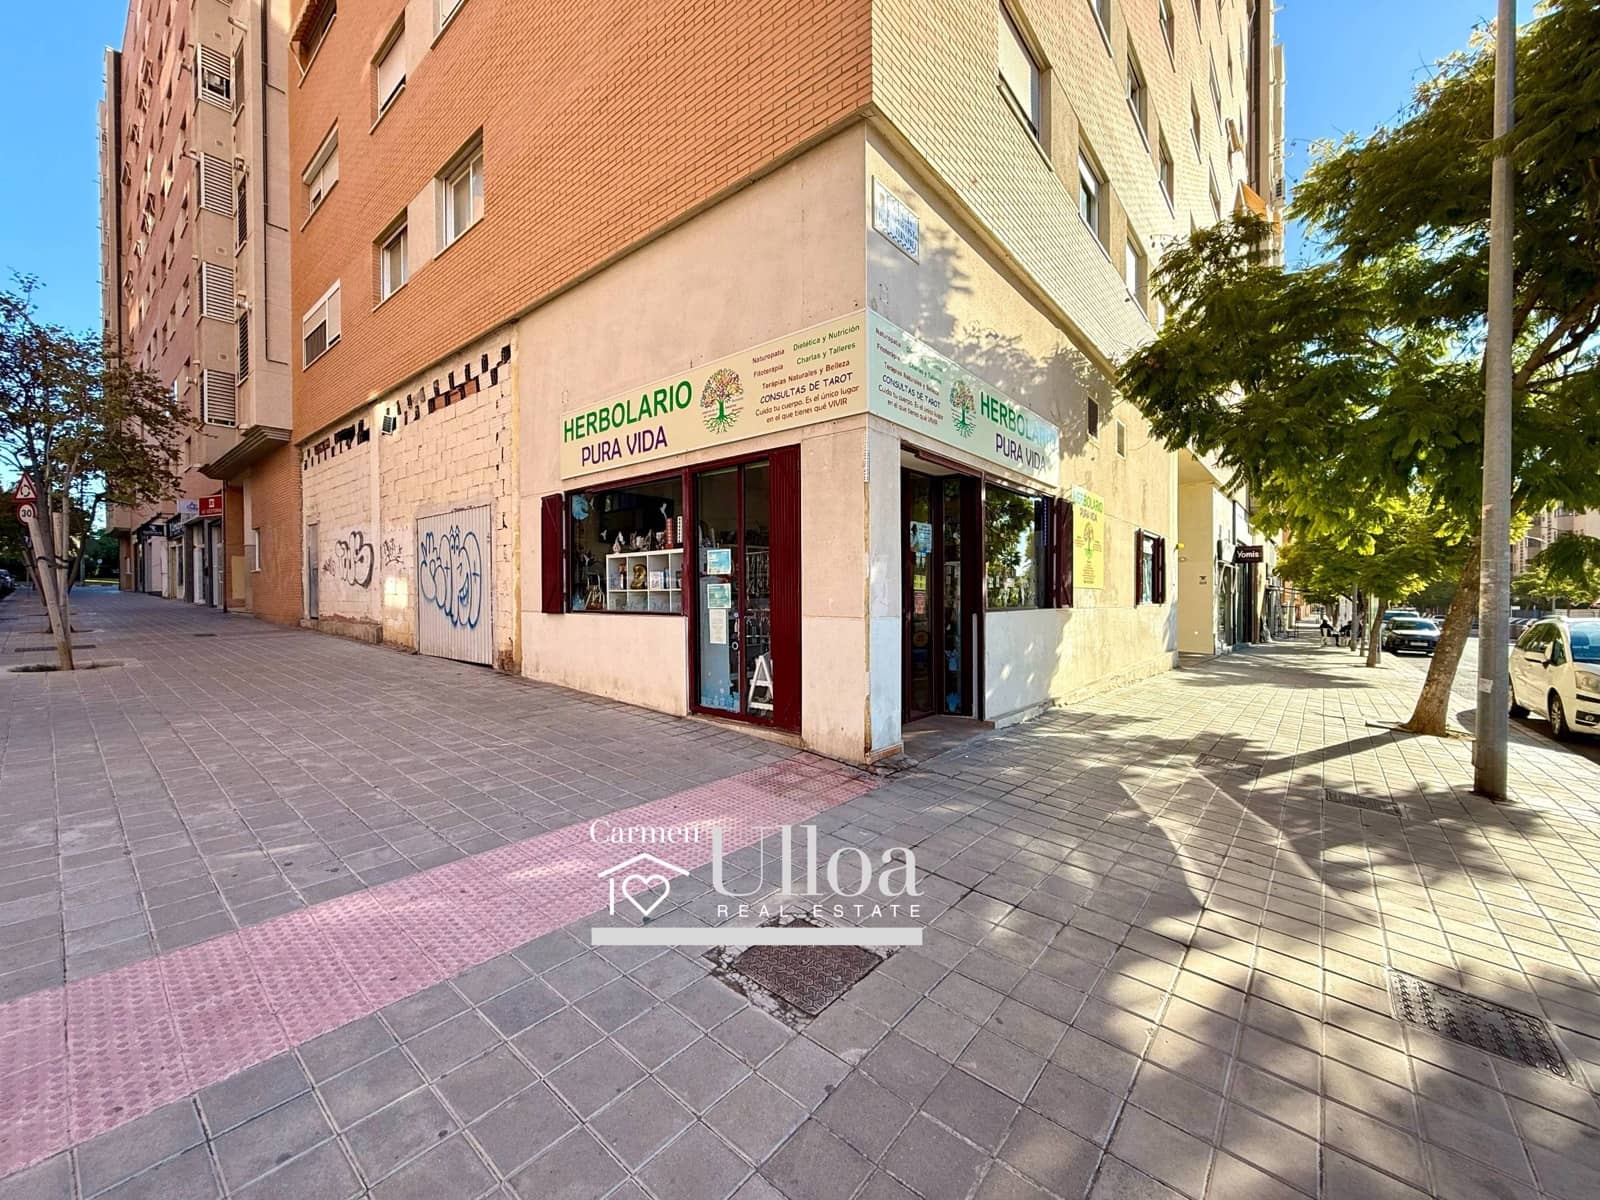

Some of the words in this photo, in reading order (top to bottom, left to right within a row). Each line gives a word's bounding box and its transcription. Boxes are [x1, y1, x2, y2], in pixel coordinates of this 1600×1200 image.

[822, 335, 827, 344] y
[828, 324, 860, 340] Nutrición
[796, 353, 821, 365] Charlas
[822, 351, 827, 359] y
[829, 342, 856, 356] Talleres
[788, 369, 818, 382] Naturales
[819, 367, 824, 375] y
[825, 360, 850, 373] Belleza
[760, 385, 806, 404] CONSULTAS
[809, 380, 820, 392] DE
[823, 372, 853, 388] TAROT
[813, 393, 820, 402] el
[820, 389, 839, 400] único
[840, 385, 860, 397] lugar
[882, 374, 915, 397] CONSULTAS
[916, 391, 924, 401] DE
[924, 395, 941, 409] TAROT
[563, 380, 692, 443] HERBOLARIO
[775, 413, 781, 421] el
[781, 412, 794, 420] que
[794, 407, 813, 417] tienes
[813, 403, 827, 414] qué
[828, 397, 848, 409] VIVIR
[581, 437, 622, 467] PURA
[626, 425, 668, 456] VIDA
[996, 433, 1023, 463] PURA
[1025, 447, 1046, 473] VIDA
[21, 509, 32, 518] 30
[1237, 550, 1260, 559] Yomis
